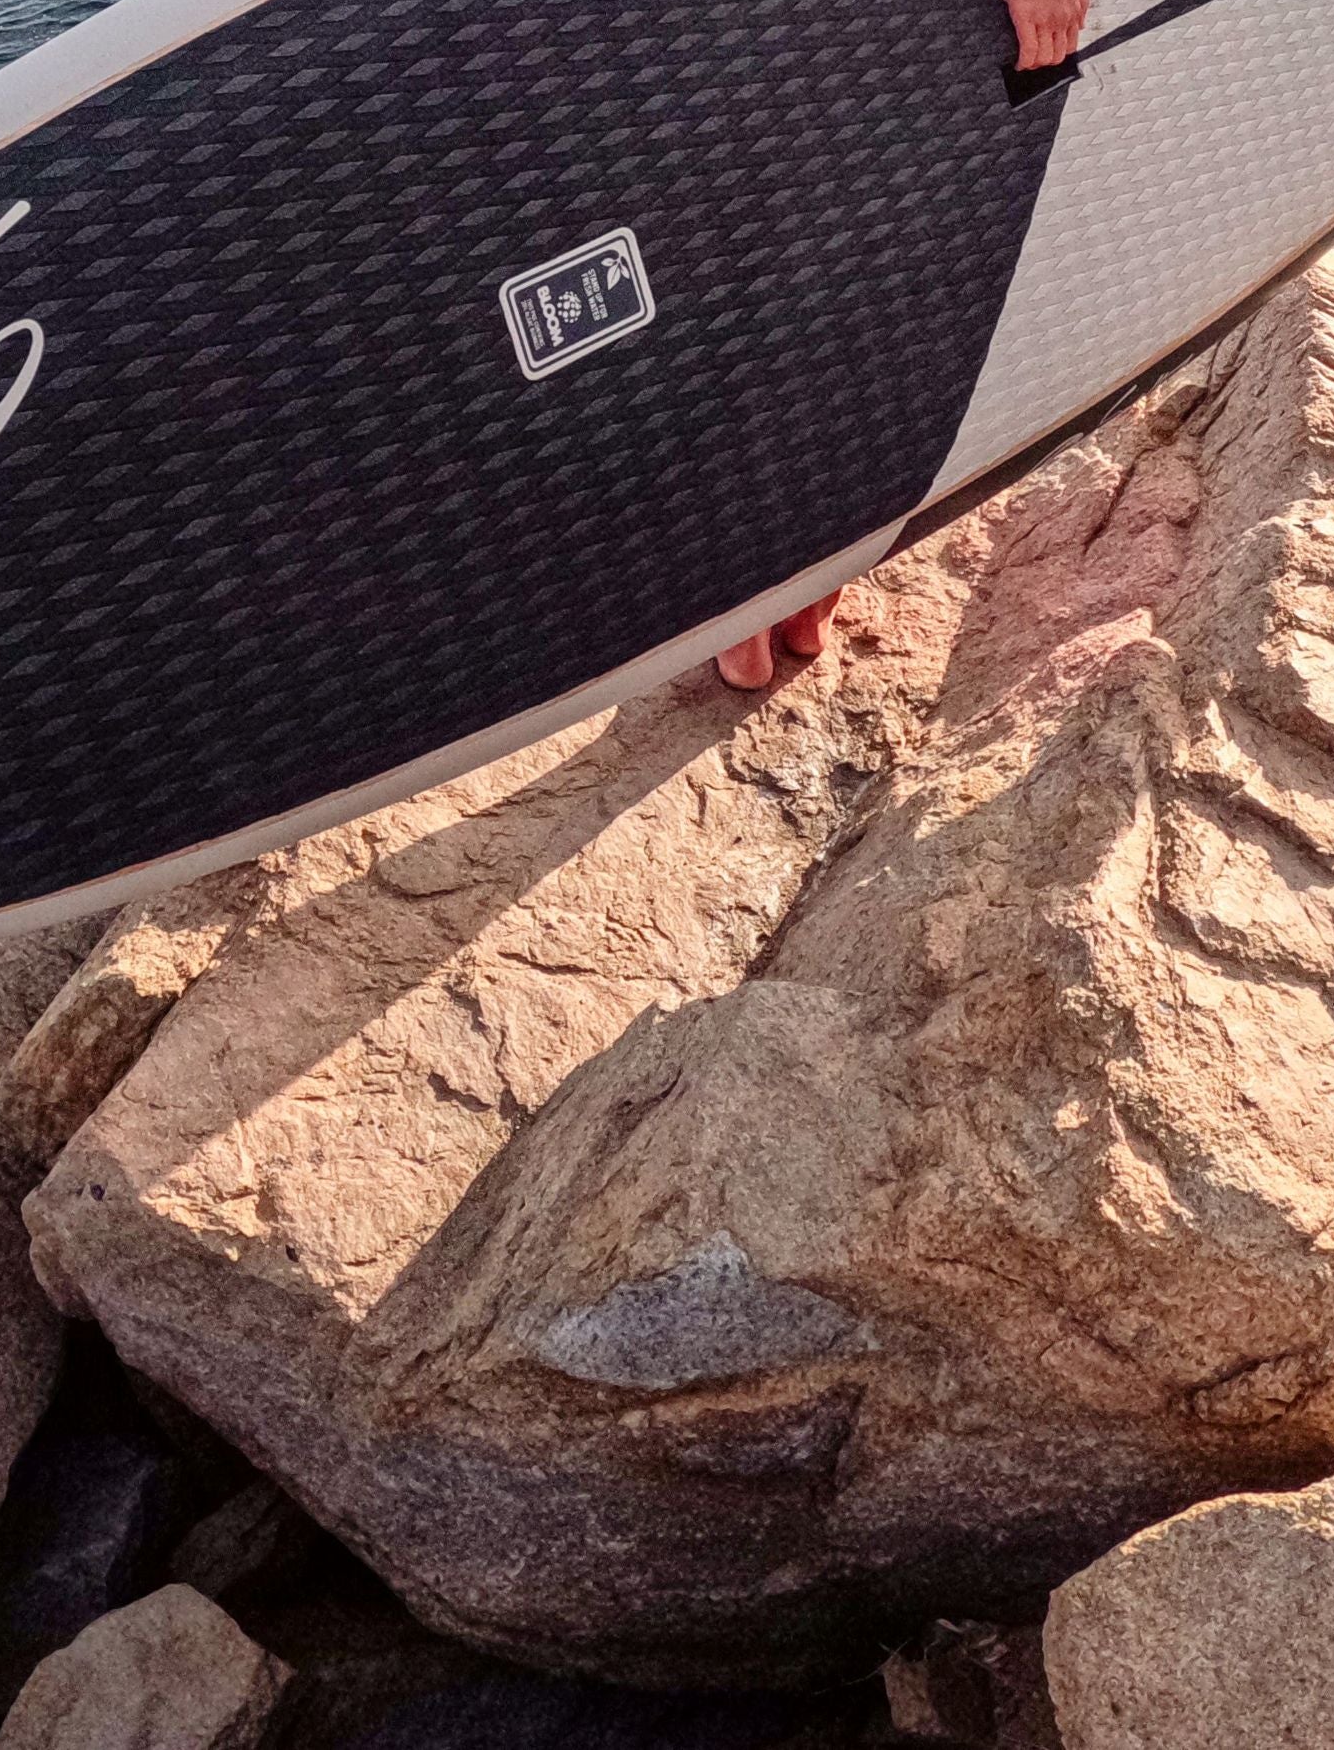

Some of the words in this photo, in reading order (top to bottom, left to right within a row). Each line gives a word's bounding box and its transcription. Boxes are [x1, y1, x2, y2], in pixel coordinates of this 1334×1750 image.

[587, 268, 600, 292] STAND
[581, 272, 594, 297] FRESH
[588, 297, 601, 321] WATER
[595, 292, 604, 303] UP
[537, 285, 564, 347] BLOOM
[599, 304, 608, 319] FOR
